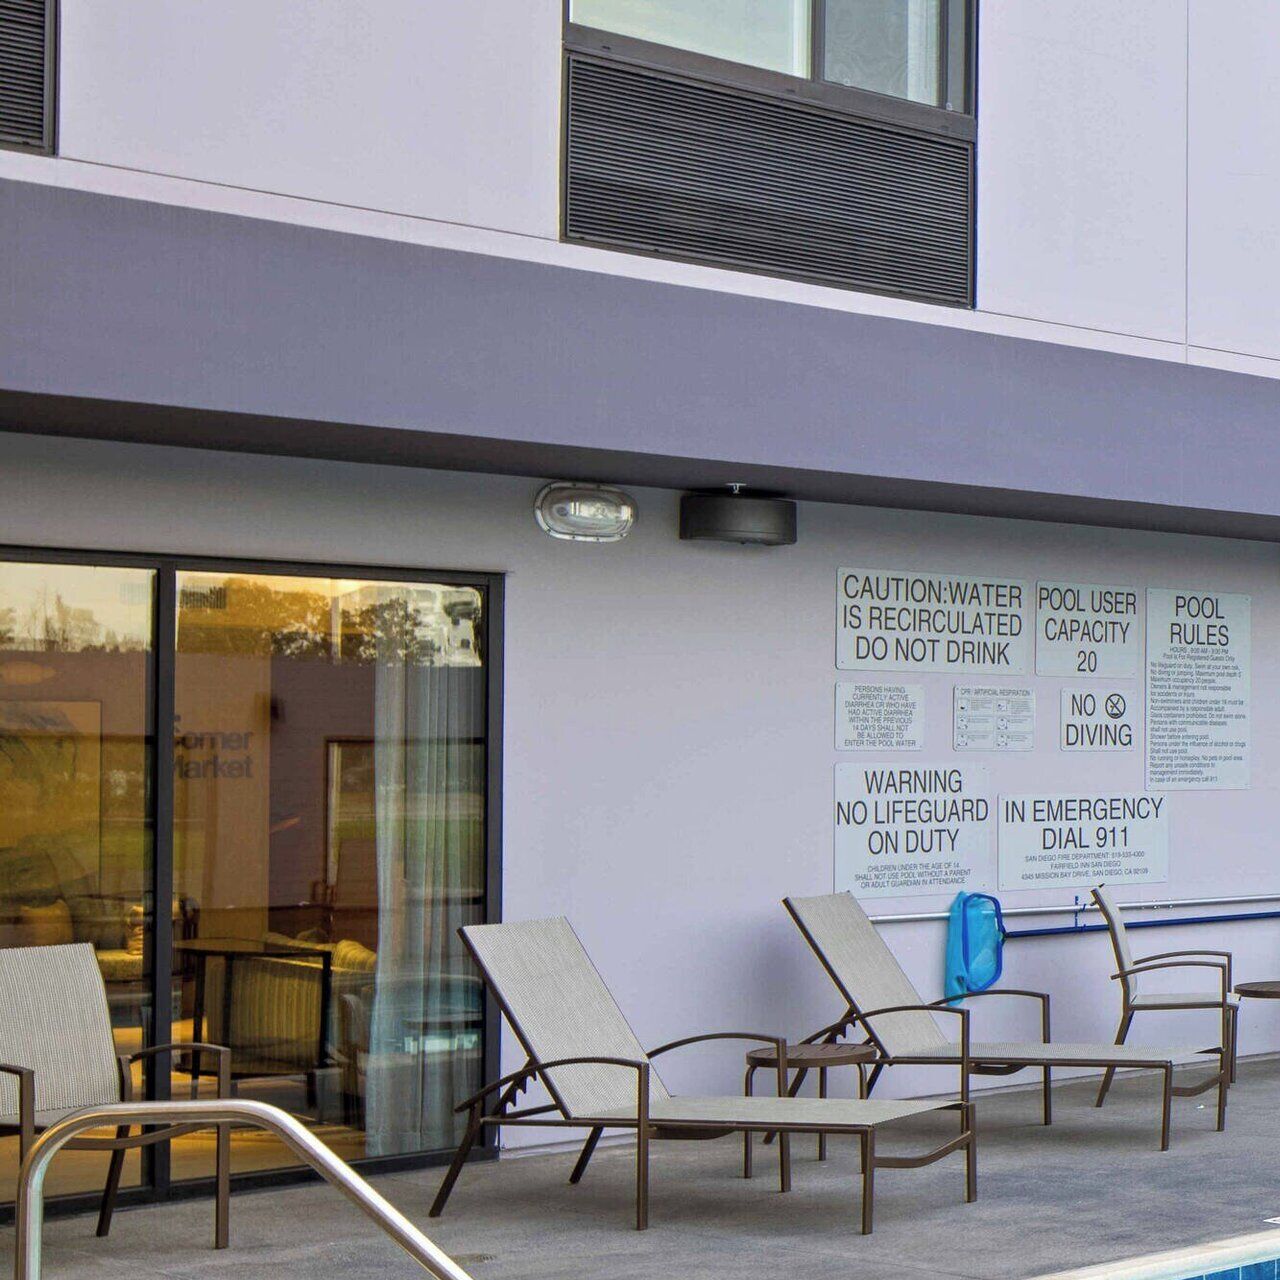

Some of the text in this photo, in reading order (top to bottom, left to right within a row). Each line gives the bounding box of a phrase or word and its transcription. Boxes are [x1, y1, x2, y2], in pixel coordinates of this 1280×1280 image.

[1039, 586, 1137, 615] POOL USER
[1175, 596, 1225, 620] POOL
[843, 605, 1022, 637] IS RECIRCULATED
[1045, 617, 1130, 644] CAPACITY
[1170, 622, 1229, 646] RULES
[855, 635, 1010, 666] DO NOT DRINK
[1077, 650, 1098, 673] 20
[855, 685, 906, 694] PERSONS HAVING
[999, 689, 1031, 697] RESPIRATION
[853, 693, 909, 702] CURRENTLY ACTIVE
[845, 701, 874, 709] DIARRHEA
[876, 701, 885, 709] OR
[901, 702, 917, 710] HAVE
[1071, 693, 1096, 717] NO
[862, 709, 883, 717] ACTIVE
[884, 709, 913, 717] DIARRHEA
[849, 716, 913, 725] WITHIN THE PREVIOUS
[877, 725, 895, 733] SHALL
[897, 725, 909, 733] NOT
[1065, 723, 1132, 747] DIVING
[867, 732, 895, 740] ALLOWED
[896, 732, 905, 740] TO
[844, 739, 917, 748] ENTER THE POOL WATER
[864, 769, 962, 793] WARNING
[836, 799, 989, 826] NO LIFEGUARD
[1005, 797, 1163, 824] IN EMERGENCY
[868, 828, 960, 855] ON DUTY
[1042, 825, 1129, 850] DIAL 911
[1025, 855, 1037, 863] SAN
[1038, 854, 1056, 862] DIEGO
[1058, 853, 1070, 861] FIRE
[868, 863, 897, 873] CHILDREN
[898, 863, 917, 871] UNDER
[918, 862, 930, 870] THE
[931, 862, 943, 870] AGE
[944, 861, 952, 869] OF
[1051, 862, 1079, 870] FAIRFIELD
[1103, 860, 1121, 868] DIEGO
[855, 872, 873, 881] SHALL
[874, 872, 886, 880] NOT
[887, 871, 899, 880] USE
[900, 870, 917, 879] POOL
[918, 869, 943, 878] WITHOUT
[949, 868, 971, 876] PARENT
[1035, 872, 1059, 880] MISSION
[1092, 870, 1104, 878] SAN
[1124, 868, 1132, 876] CA
[860, 877, 965, 889] OR ADULT GUARDIAN IN ATTENDANCE
